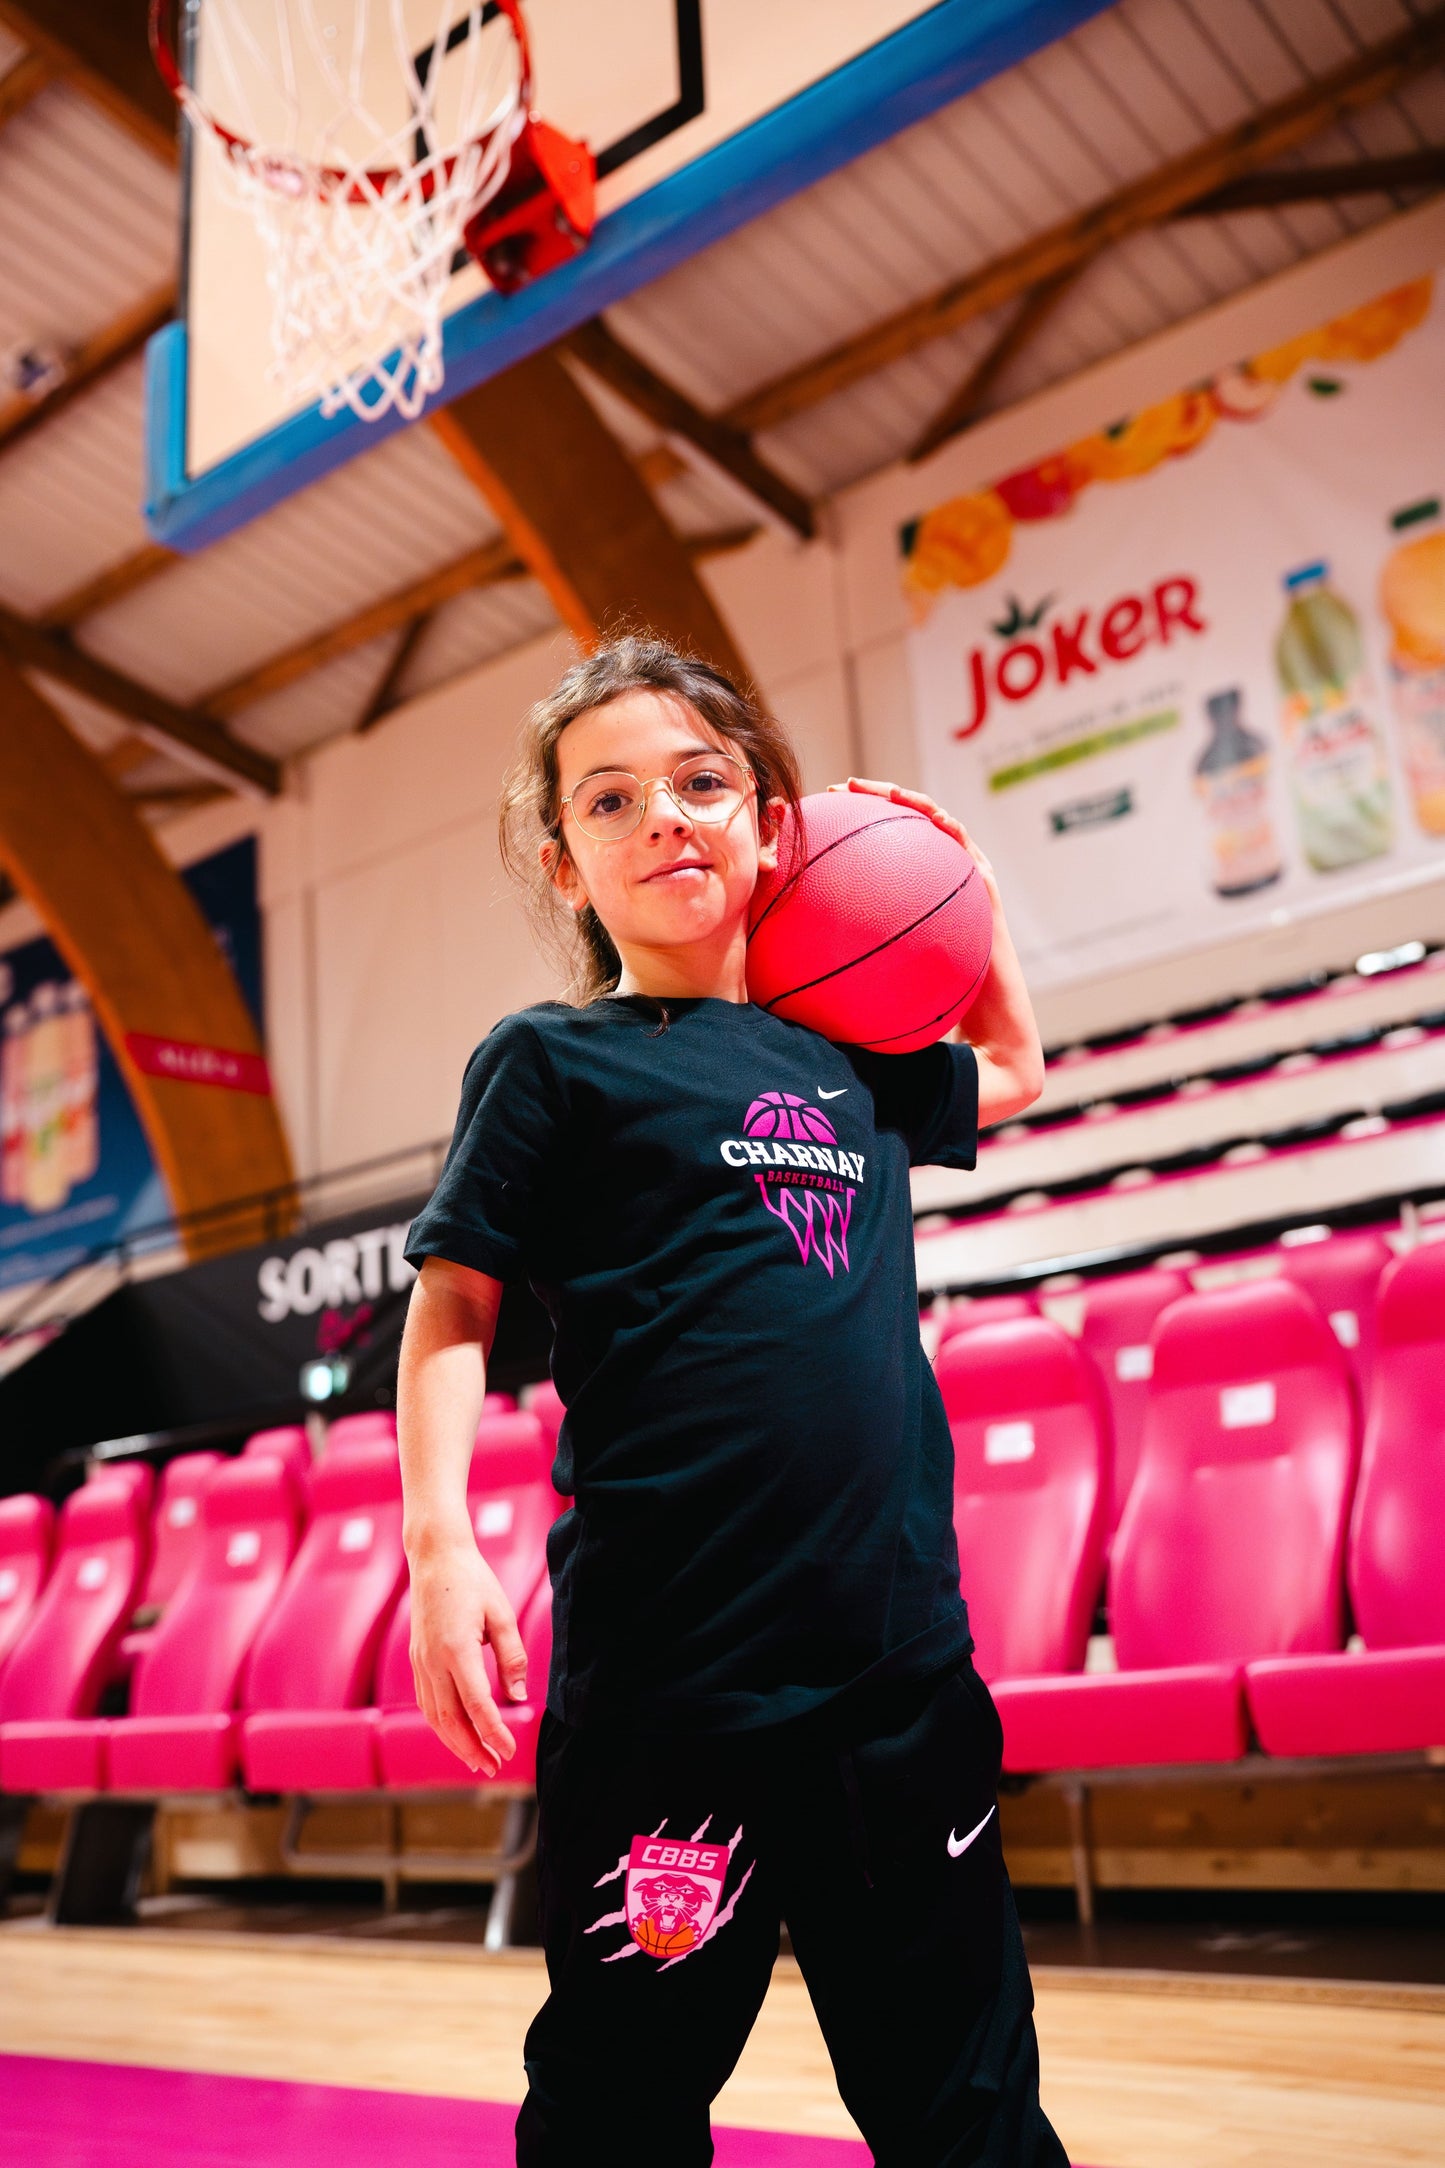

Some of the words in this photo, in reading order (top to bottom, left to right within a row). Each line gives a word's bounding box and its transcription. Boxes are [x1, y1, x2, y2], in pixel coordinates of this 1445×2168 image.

[720, 1139, 865, 1184] CHARNAY
[767, 1170, 845, 1193] BASKETBALL
[257, 1219, 421, 1323] SORTI
[641, 1844, 719, 1871] CBBS
